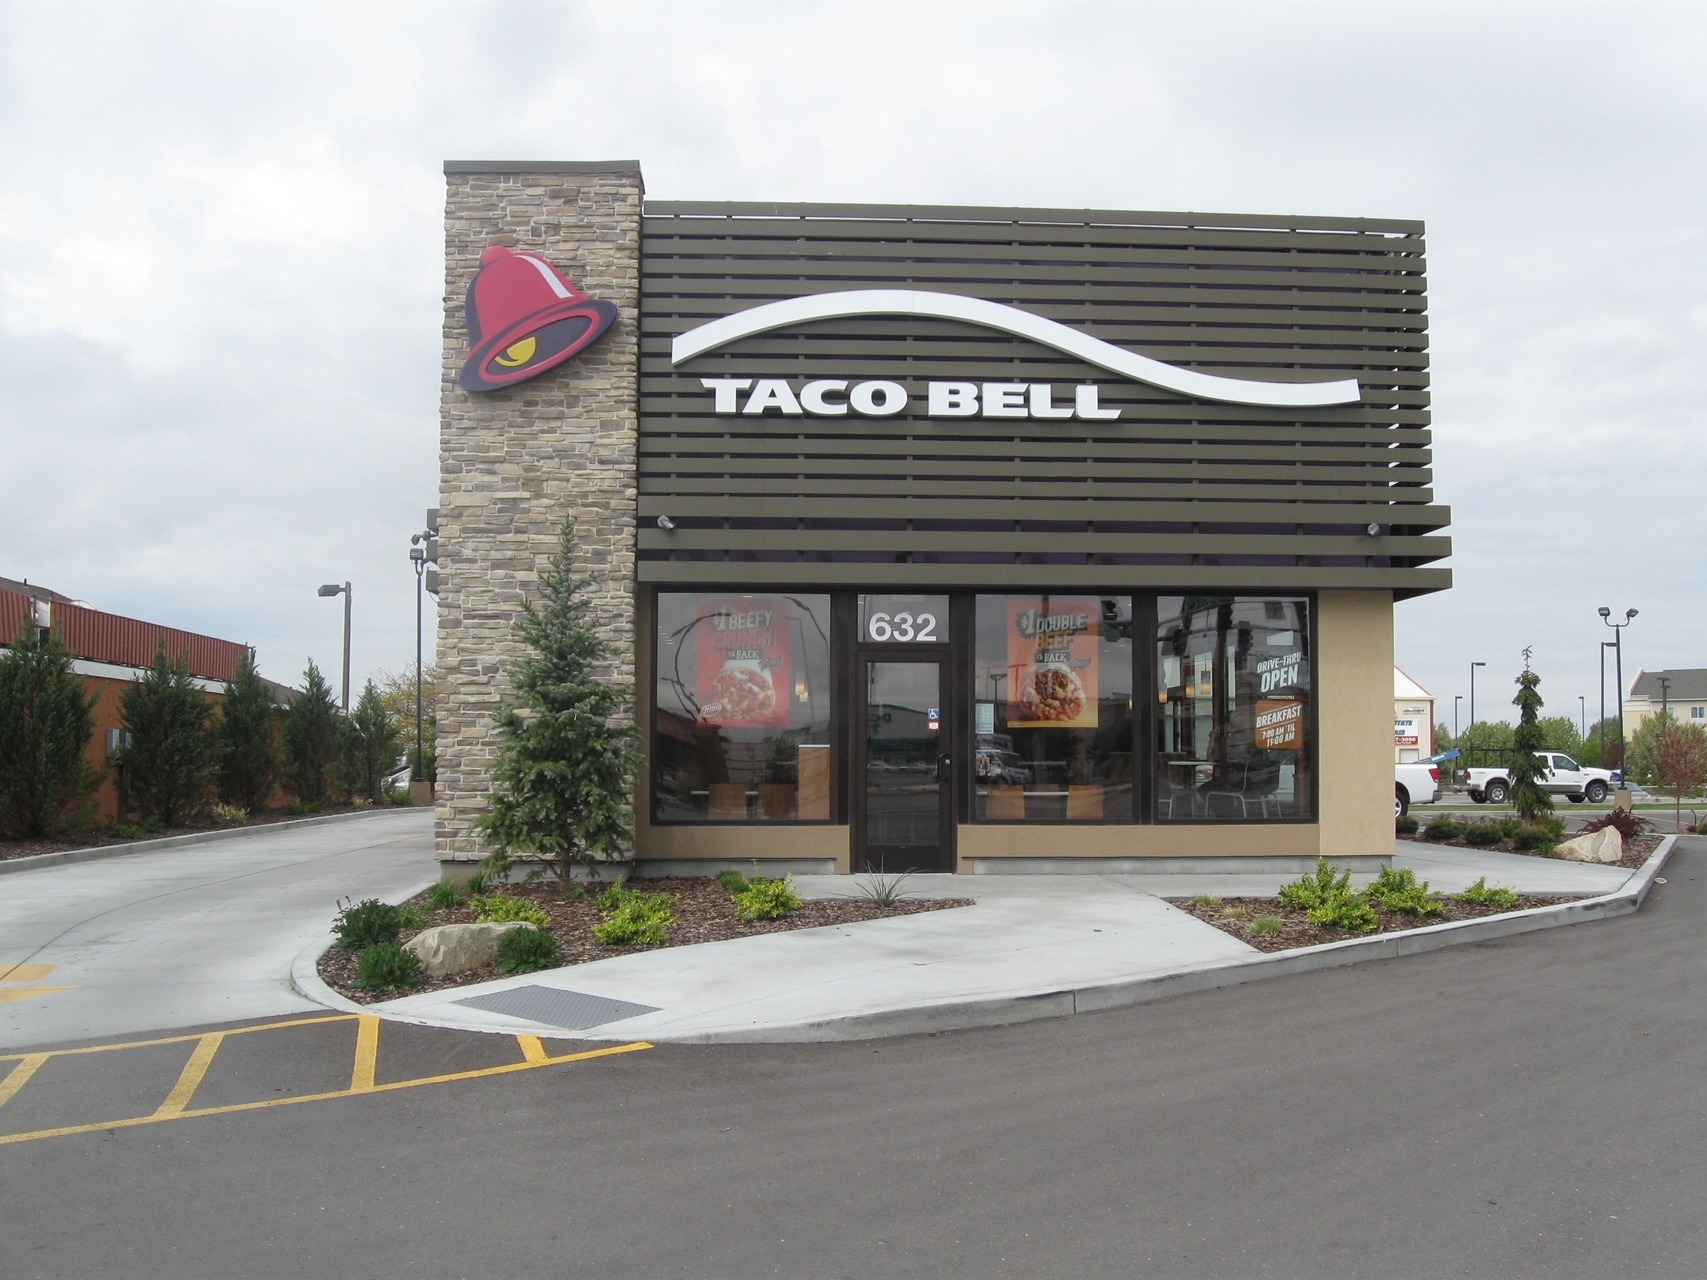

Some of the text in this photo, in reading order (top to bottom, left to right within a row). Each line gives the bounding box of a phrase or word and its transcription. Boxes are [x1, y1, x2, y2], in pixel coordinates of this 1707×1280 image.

[700, 378, 1122, 420] TACO BELL
[728, 610, 773, 630] BEEFY
[869, 612, 937, 642] 632
[1021, 608, 1086, 634] $1 DOUBLE
[1036, 630, 1074, 650] BEEF
[736, 649, 760, 660] BACK
[1044, 652, 1067, 662] BACK
[1256, 651, 1302, 674] DRIVE-THRU
[1260, 664, 1299, 693] OPEN
[1256, 705, 1302, 728] BREAKFAST
[1267, 732, 1295, 748] 11:00 AM
[1275, 727, 1285, 737] AM
